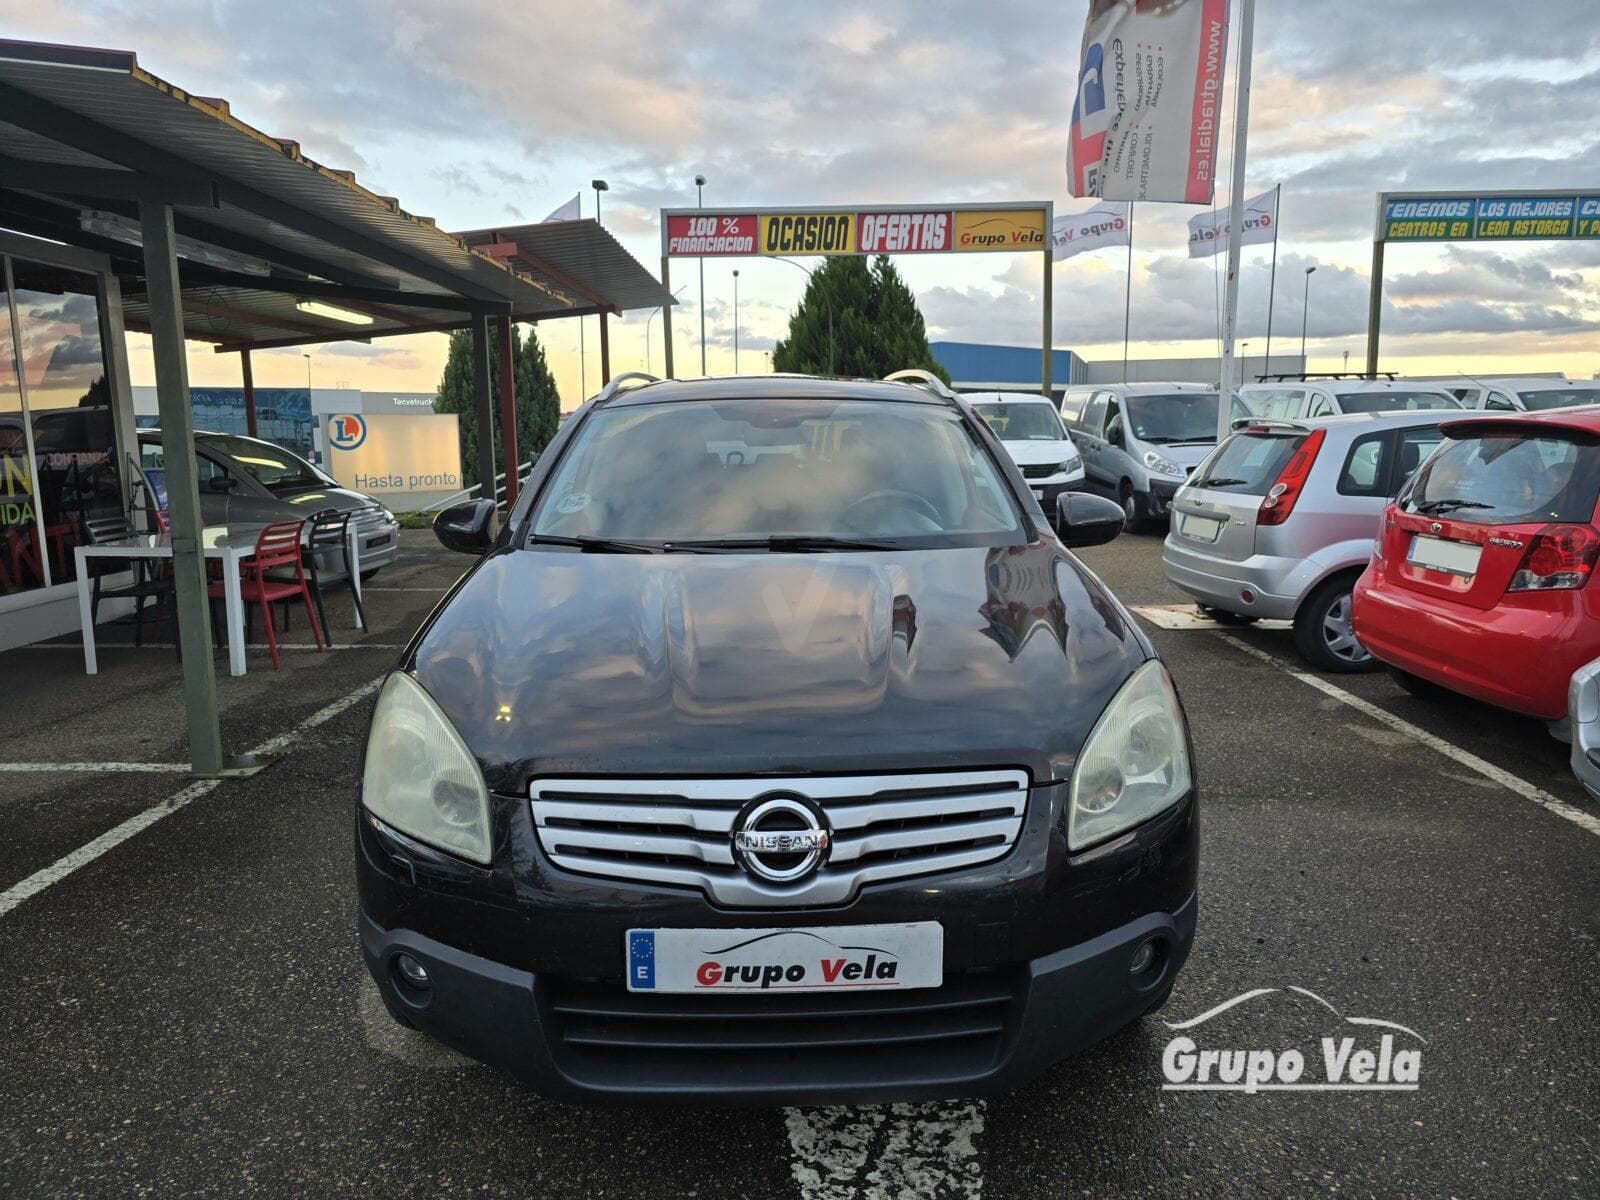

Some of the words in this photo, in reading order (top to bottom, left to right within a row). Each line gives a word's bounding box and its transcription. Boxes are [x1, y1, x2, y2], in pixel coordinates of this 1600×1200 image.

[1479, 202, 1506, 217] LOS
[1507, 201, 1573, 217] MEJORES
[687, 217, 718, 237] 100
[766, 216, 850, 252] OCASION
[861, 214, 947, 251] OFERTAS
[1389, 221, 1447, 237] CENTROS
[1450, 221, 1468, 237] EN
[1479, 221, 1510, 236] LEON
[1512, 220, 1569, 236] ASTORGA
[669, 236, 754, 253] FINANCIACION
[960, 232, 1005, 246] Grupo
[1011, 230, 1044, 245] Vela
[355, 474, 403, 489] Hasta
[409, 472, 457, 490] pronto
[745, 834, 819, 849] NISSAN
[637, 966, 648, 979] E
[696, 961, 806, 989] Grupo
[820, 954, 899, 983] Vela
